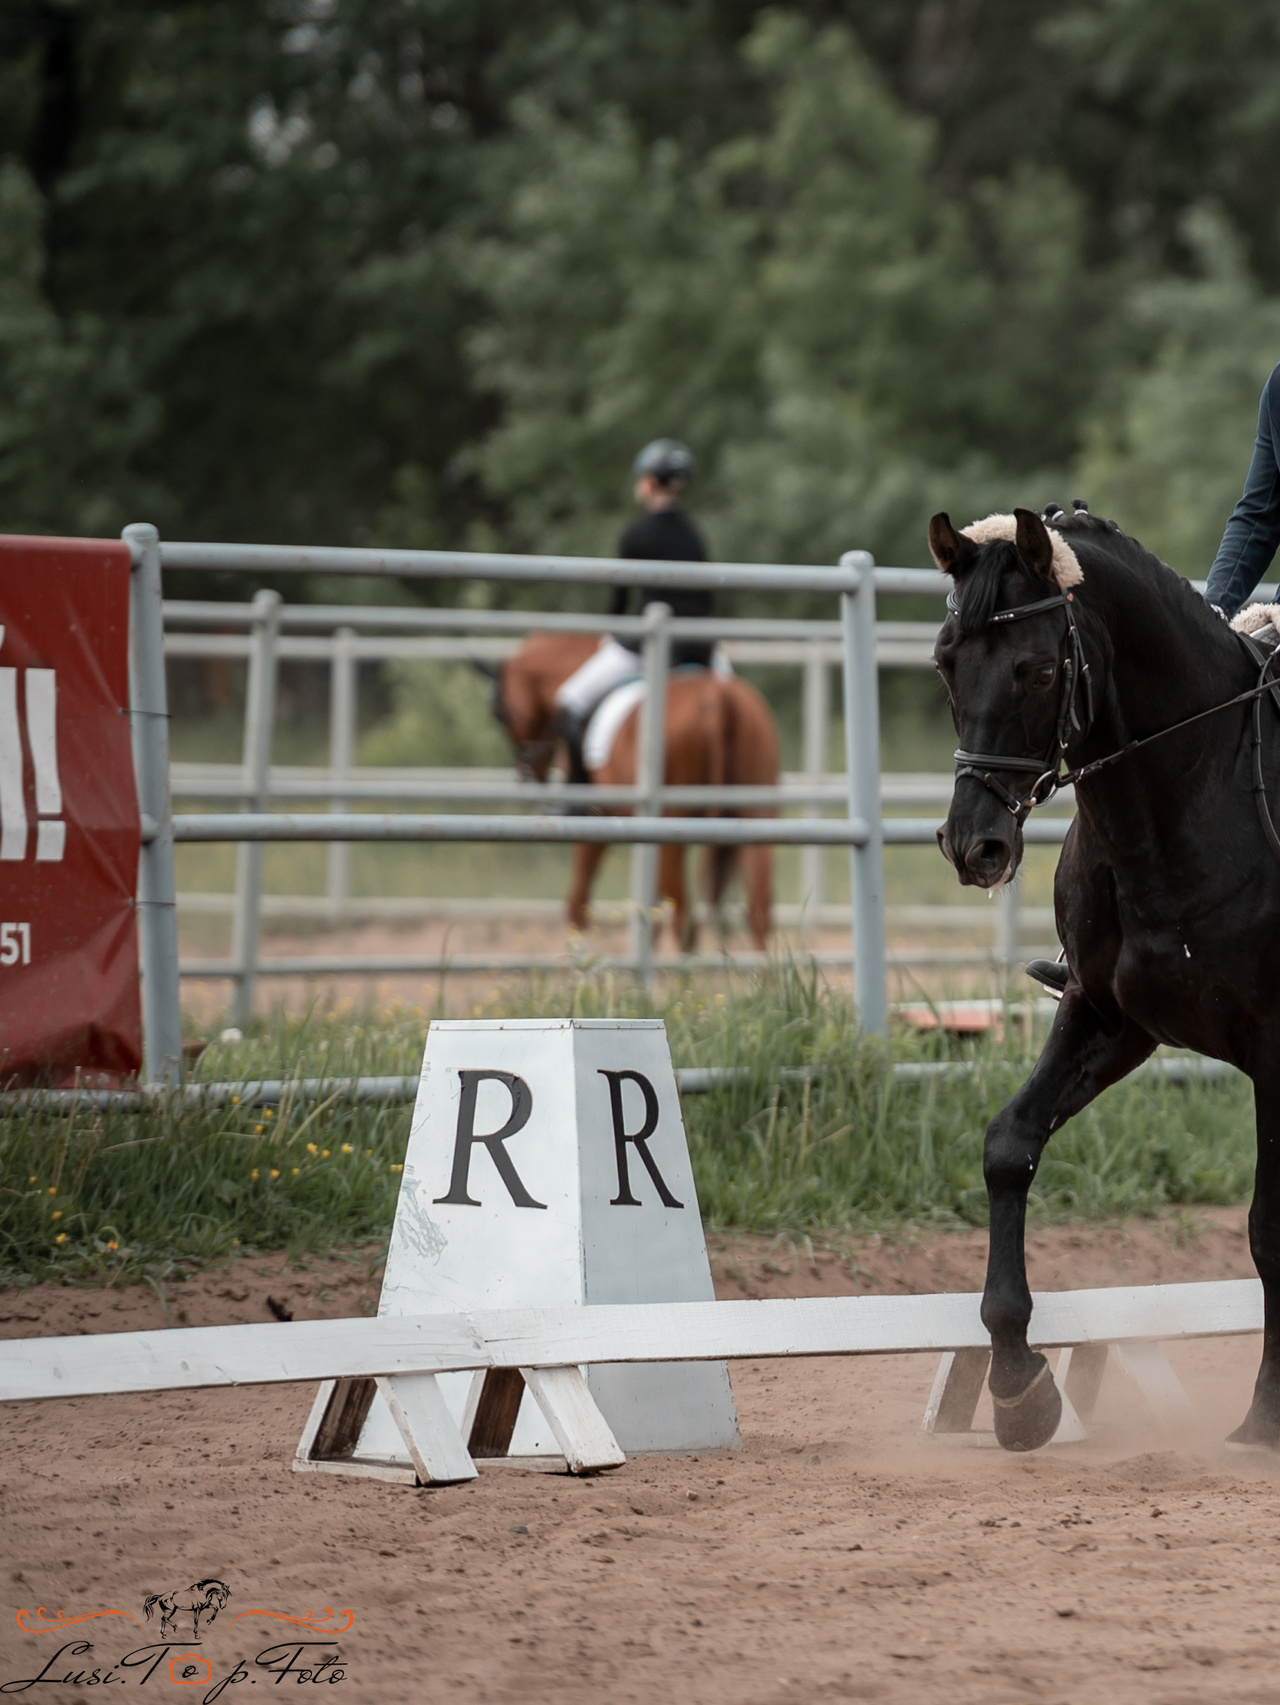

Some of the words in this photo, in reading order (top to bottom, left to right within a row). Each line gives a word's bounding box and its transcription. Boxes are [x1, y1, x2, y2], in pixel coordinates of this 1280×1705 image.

[0, 922, 31, 965] 51
[432, 1068, 549, 1210] R
[596, 1068, 685, 1210] R
